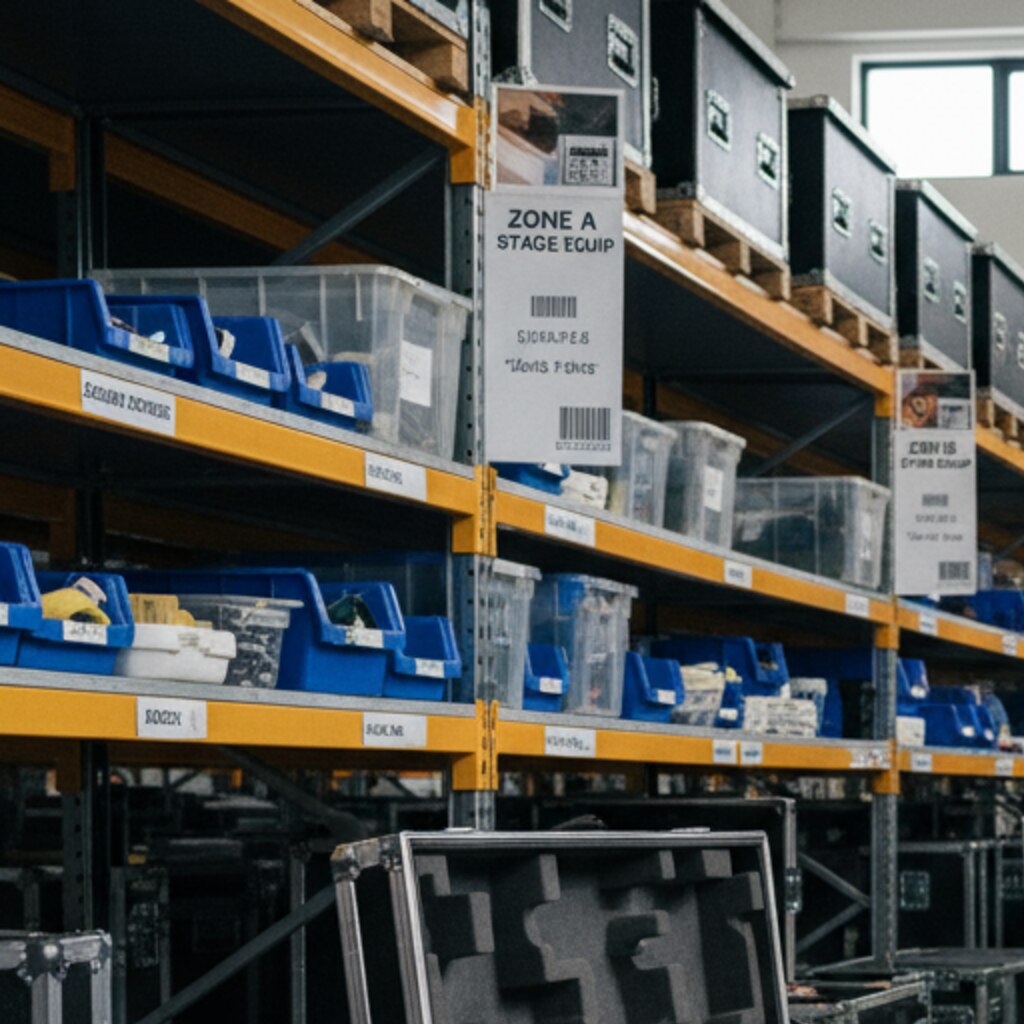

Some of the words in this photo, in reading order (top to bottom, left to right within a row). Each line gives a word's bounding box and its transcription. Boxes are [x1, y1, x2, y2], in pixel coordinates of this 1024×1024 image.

[507, 208, 573, 230] ZONE
[580, 211, 597, 231] A
[497, 234, 559, 253] STAGE
